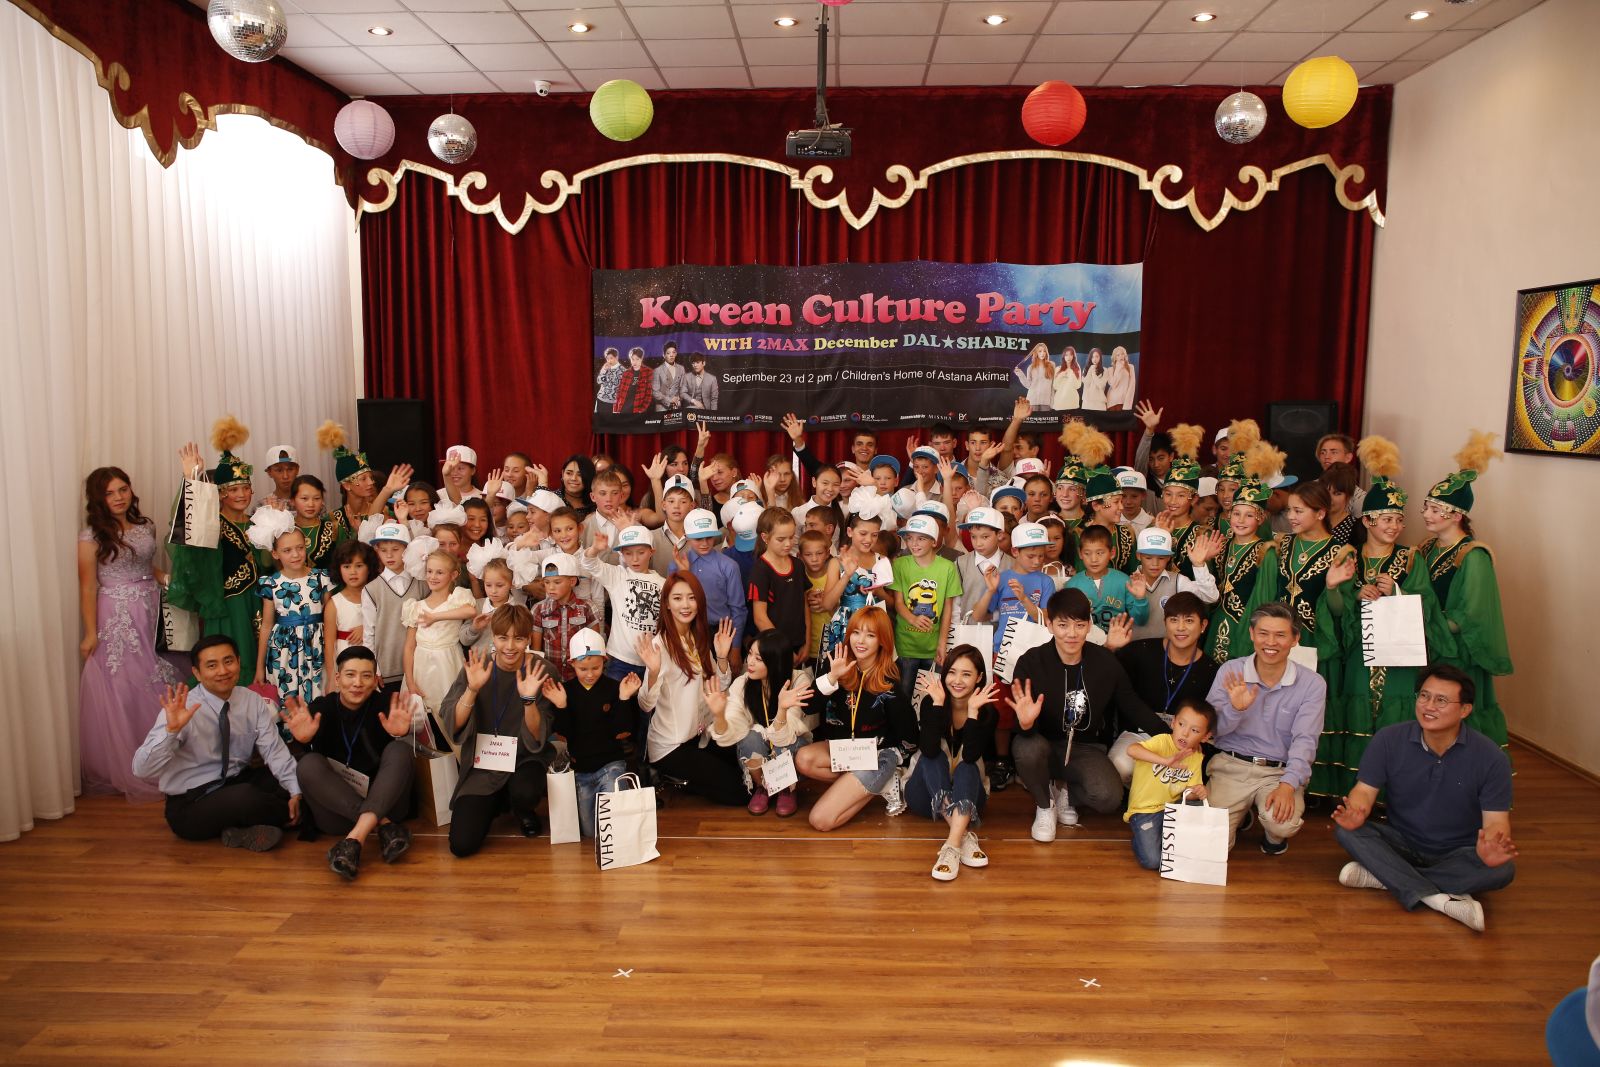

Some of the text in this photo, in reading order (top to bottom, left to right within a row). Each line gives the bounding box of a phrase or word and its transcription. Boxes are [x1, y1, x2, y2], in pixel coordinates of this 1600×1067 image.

[640, 292, 1097, 330] Korean Culture Party
[703, 337, 752, 351] WITH
[756, 338, 809, 352] 2MAX
[814, 336, 898, 351] December
[722, 372, 777, 386] September
[779, 373, 792, 383] 23
[795, 373, 805, 383] rd
[807, 373, 814, 383] 2
[816, 374, 833, 385] pm
[841, 370, 891, 381] Children's
[893, 369, 923, 380] Home
[926, 368, 936, 379] of
[937, 370, 973, 382] Astana
[975, 371, 1009, 382] Akimat
[185, 481, 193, 541] MISSHA
[993, 619, 1017, 673] MISSHA
[1361, 600, 1376, 663] MISSHA
[599, 798, 614, 867] MISSHA
[1161, 806, 1177, 873] MISSHA
